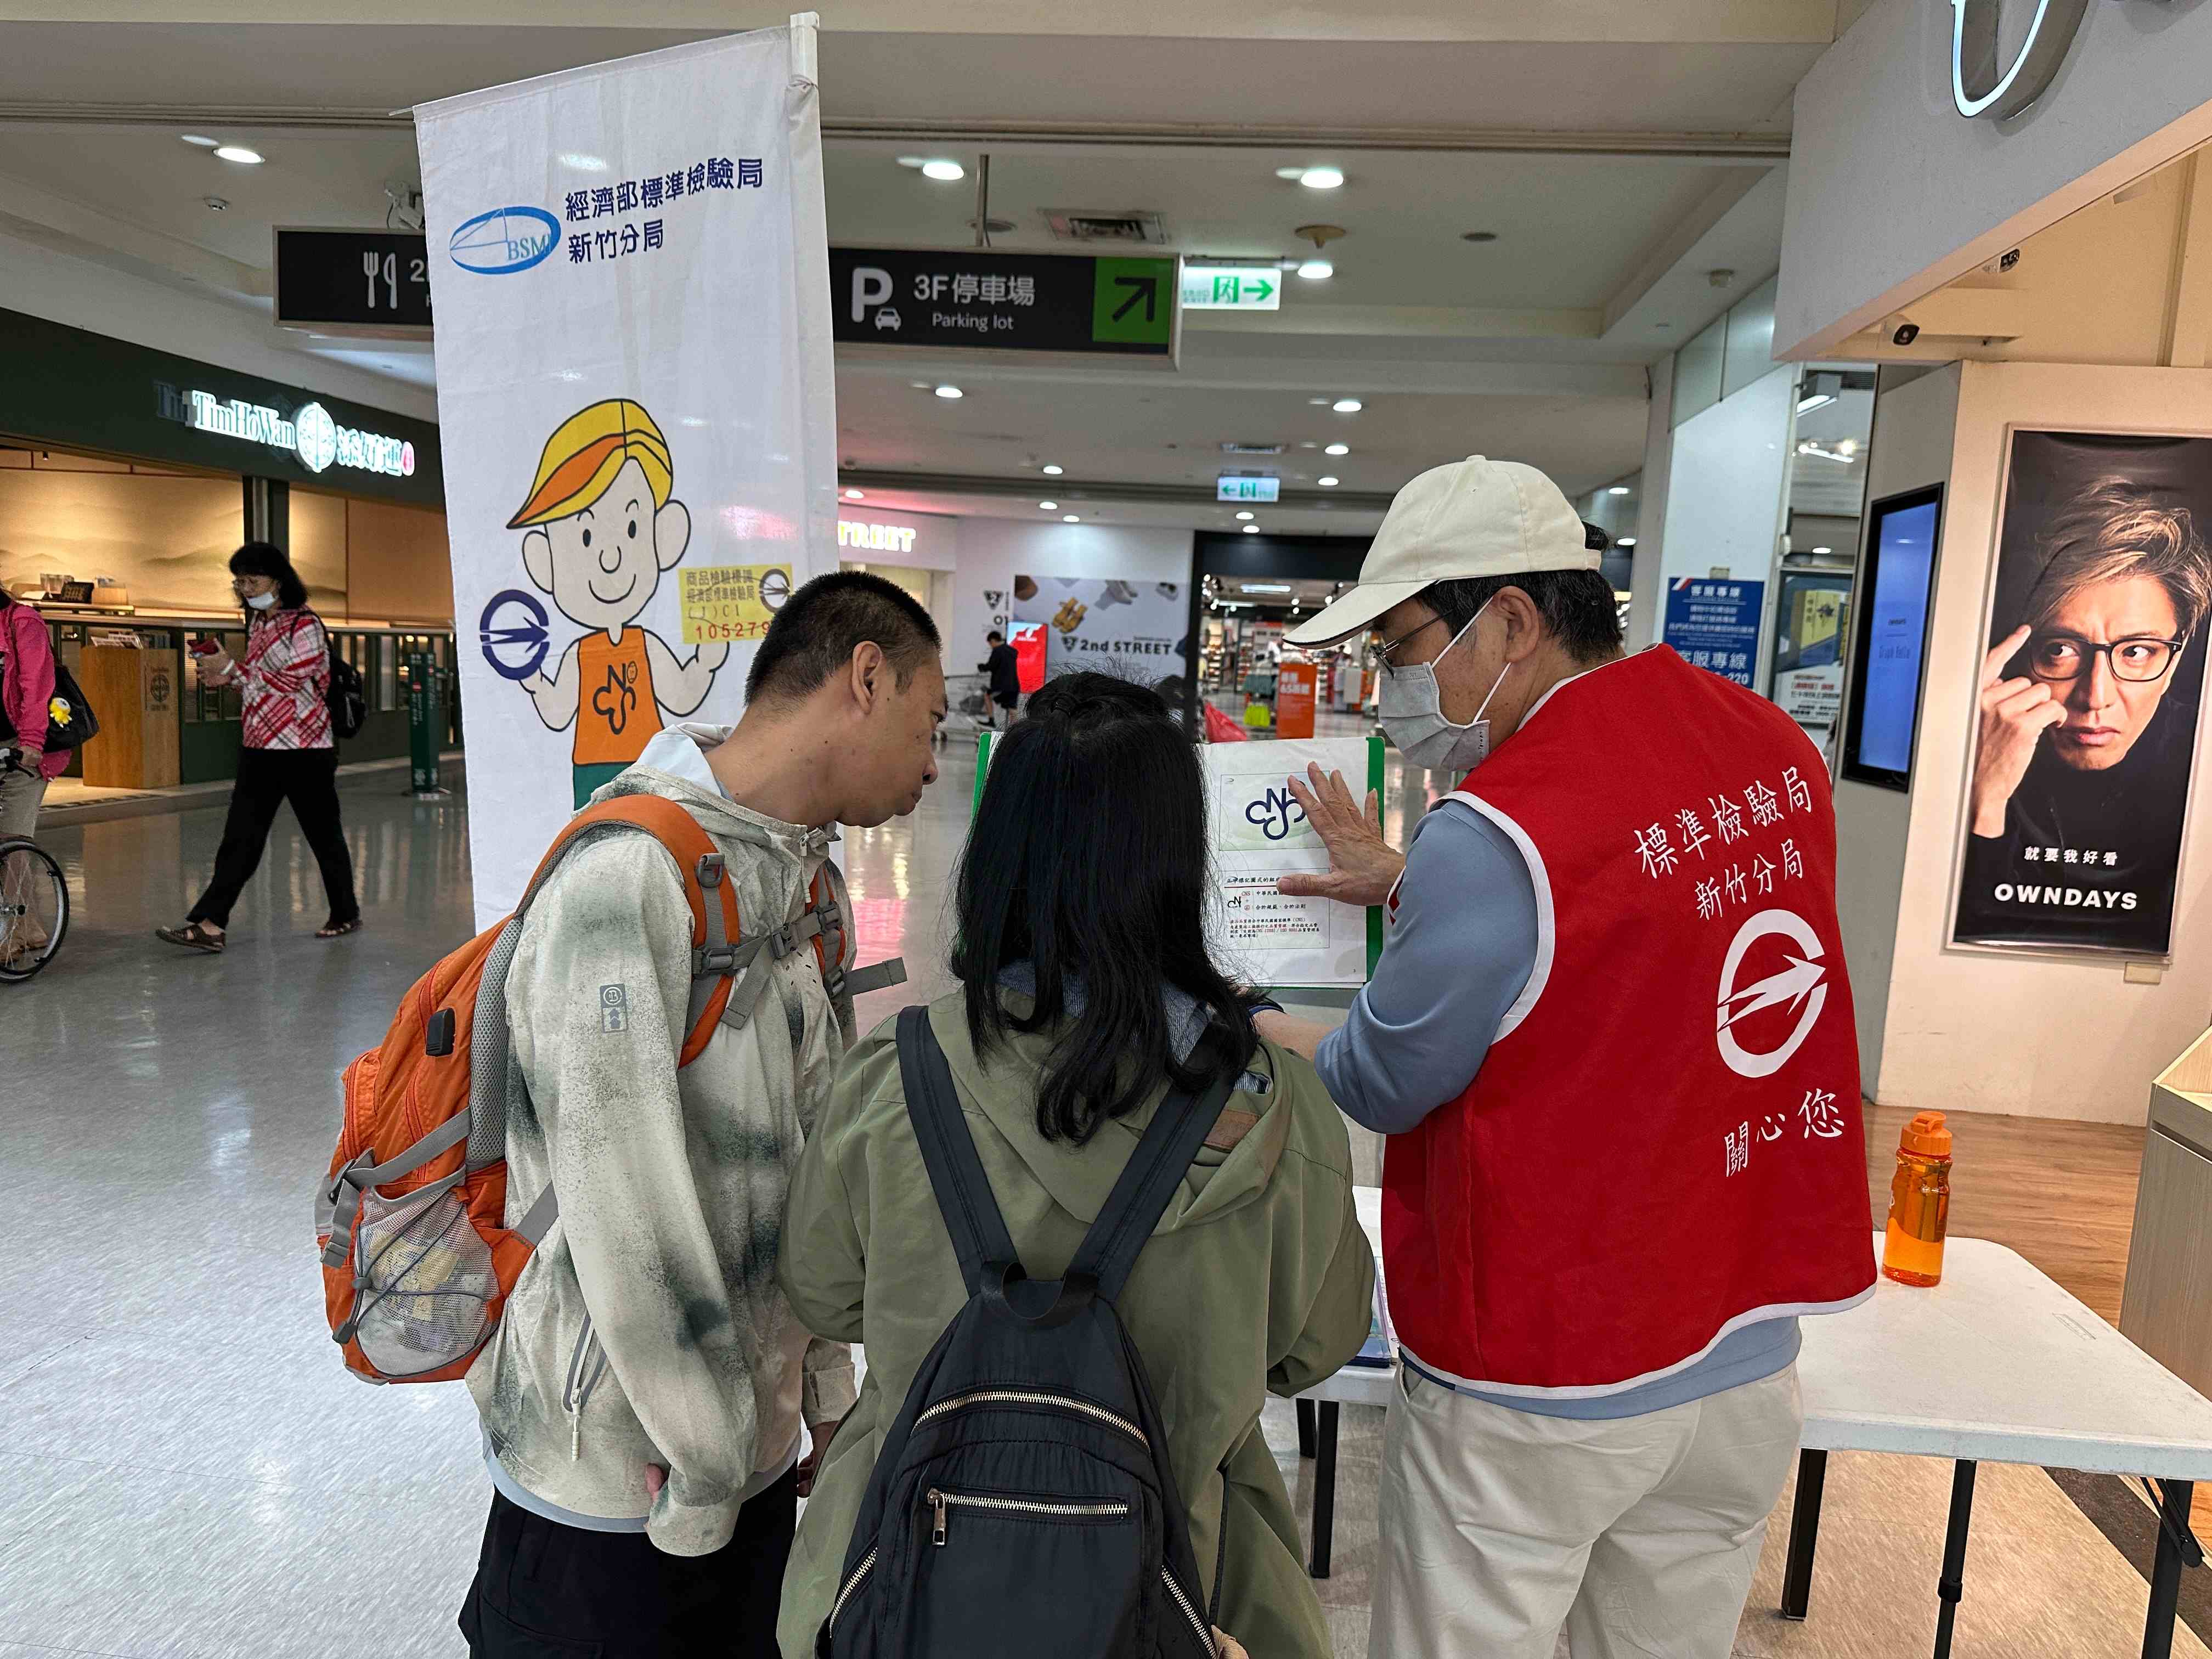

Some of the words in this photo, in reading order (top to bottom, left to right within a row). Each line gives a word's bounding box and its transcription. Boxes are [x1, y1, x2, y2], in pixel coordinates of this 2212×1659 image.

[565, 157, 763, 222] 經濟部標準檢驗局
[568, 219, 664, 264] 新竹分局
[410, 259, 430, 283] 2
[932, 312, 988, 331] Parking
[991, 313, 1014, 330] lot
[1081, 639, 1109, 652] 2nd
[1114, 641, 1172, 654] STREET
[1634, 766, 1813, 879] 標準檢驗局
[2024, 845, 2118, 866] 就要我好看
[1695, 838, 1804, 921] 新竹分局
[1994, 883, 2138, 910] OWNDAYS
[1725, 1088, 1845, 1178] 關心您
